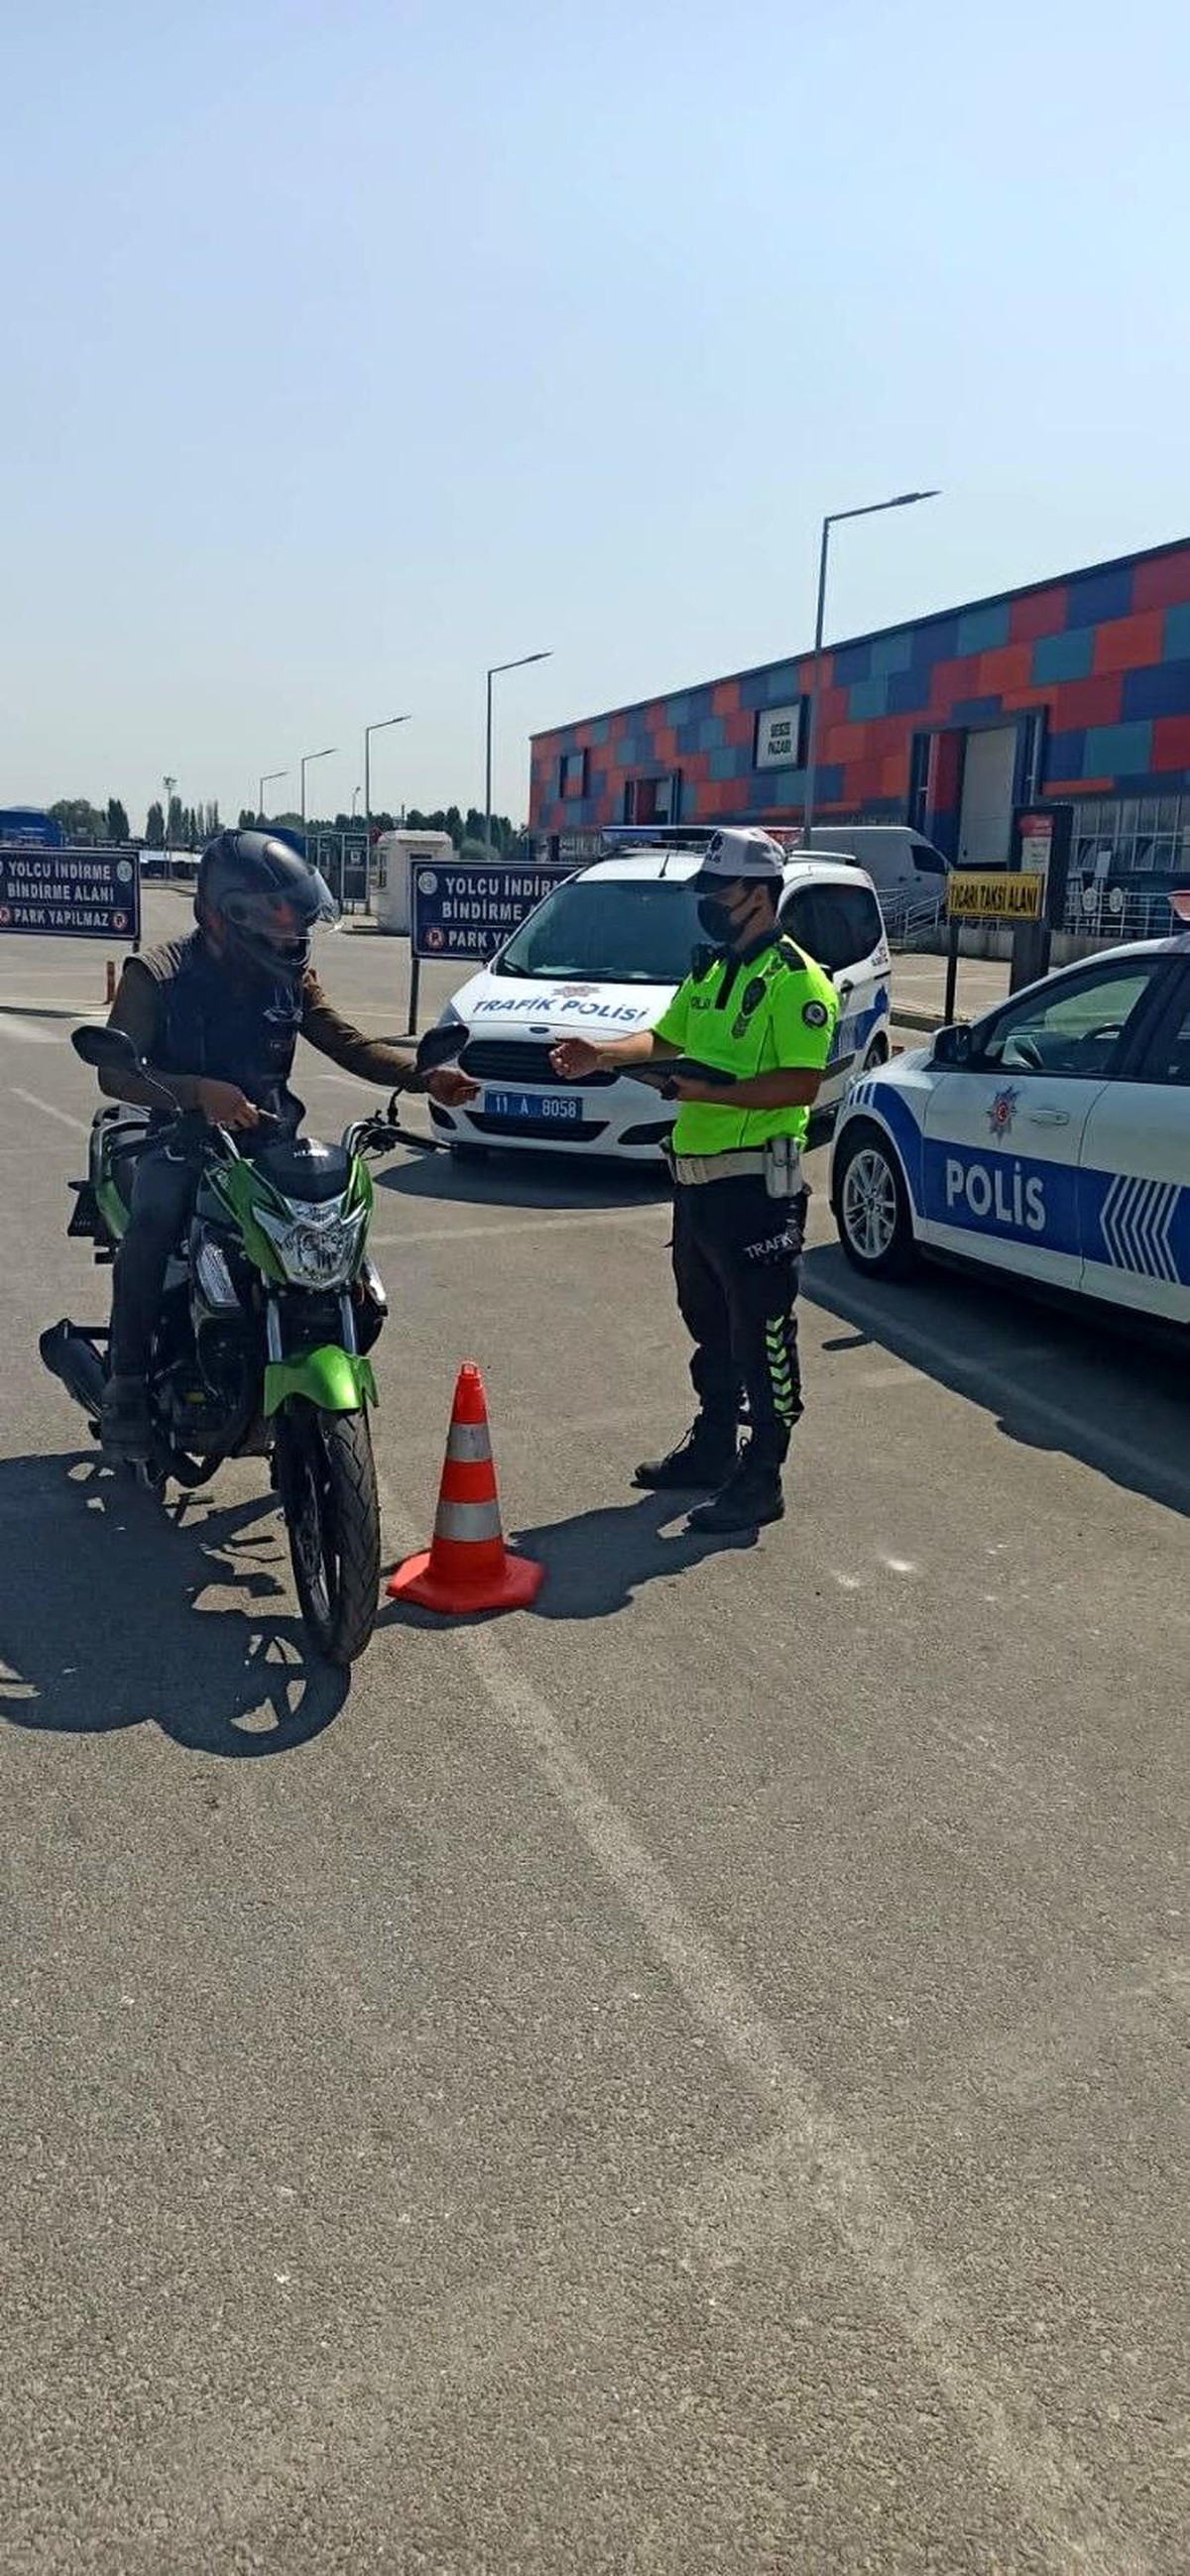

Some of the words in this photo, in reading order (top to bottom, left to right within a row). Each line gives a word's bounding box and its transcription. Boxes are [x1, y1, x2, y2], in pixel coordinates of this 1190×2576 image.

[8, 861, 51, 878] YOLCU
[55, 861, 111, 879] İNDİRME
[7, 879, 71, 900] BİNDİRME
[74, 884, 114, 902] ALANI
[445, 878, 499, 895] YOLCU
[504, 875, 558, 896] İNDİR
[14, 908, 46, 924] PARK
[48, 909, 109, 927] YAPILMAZ
[442, 898, 523, 921] BİNDİRME
[448, 930, 488, 948] PARK
[472, 996, 555, 1013] TRAFİK
[560, 999, 650, 1023] POLİSİ
[495, 1096, 509, 1112] 11
[521, 1098, 530, 1115] A
[541, 1099, 577, 1118] 8058
[945, 1158, 1047, 1232] POLİS
